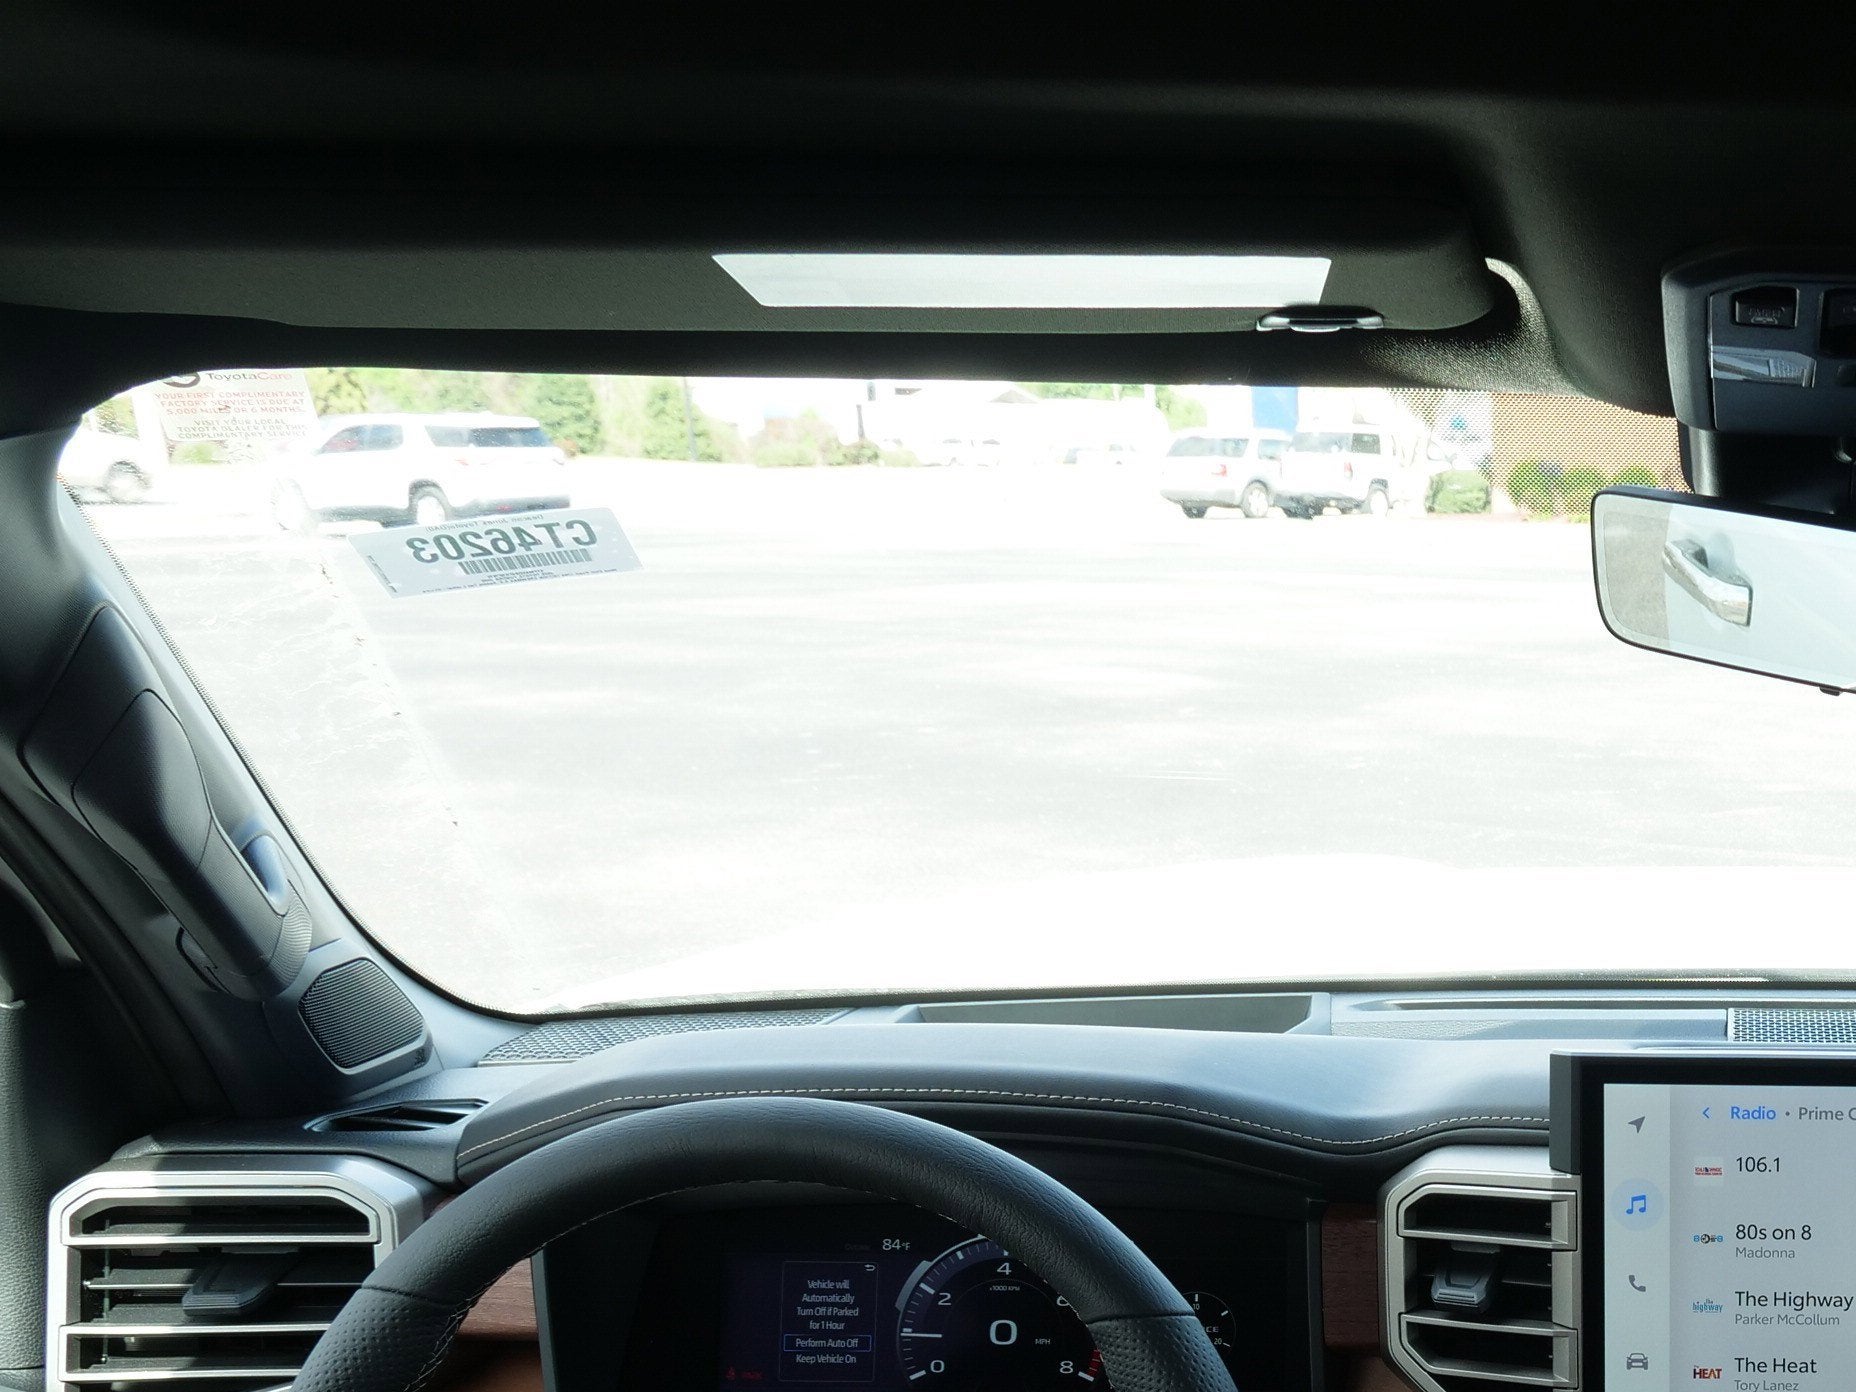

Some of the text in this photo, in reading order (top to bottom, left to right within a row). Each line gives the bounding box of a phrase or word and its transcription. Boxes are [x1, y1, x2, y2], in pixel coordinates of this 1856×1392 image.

[1730, 1106, 1776, 1120] Radio
[1798, 1107, 1844, 1121] Prime
[1736, 1156, 1781, 1173] 106.1
[1735, 1224, 1767, 1241] 80s
[1772, 1228, 1796, 1241] on
[1801, 1224, 1812, 1241] 8
[1735, 1246, 1796, 1259] Madonna
[996, 1262, 1012, 1275] 4
[808, 1279, 850, 1290] Vehicle will
[802, 1293, 855, 1305] Automatically
[938, 1292, 952, 1306] 2
[1735, 1291, 1854, 1311] The Highway
[797, 1307, 815, 1316] Turn
[816, 1307, 827, 1316] Off
[833, 1307, 859, 1316] Parked
[809, 1320, 820, 1330] for
[826, 1321, 846, 1330] Hour
[1735, 1314, 1840, 1326] Parker McCollum
[989, 1319, 1018, 1347] 0
[796, 1339, 859, 1348] Perform Auto Off
[796, 1355, 857, 1365] Keep Vehicle On
[930, 1359, 945, 1374] 0
[1734, 1357, 1817, 1374] The Heat
[1059, 1360, 1074, 1375] 8
[1693, 1368, 1722, 1379] HEAT
[1763, 1380, 1799, 1392] Lanez
